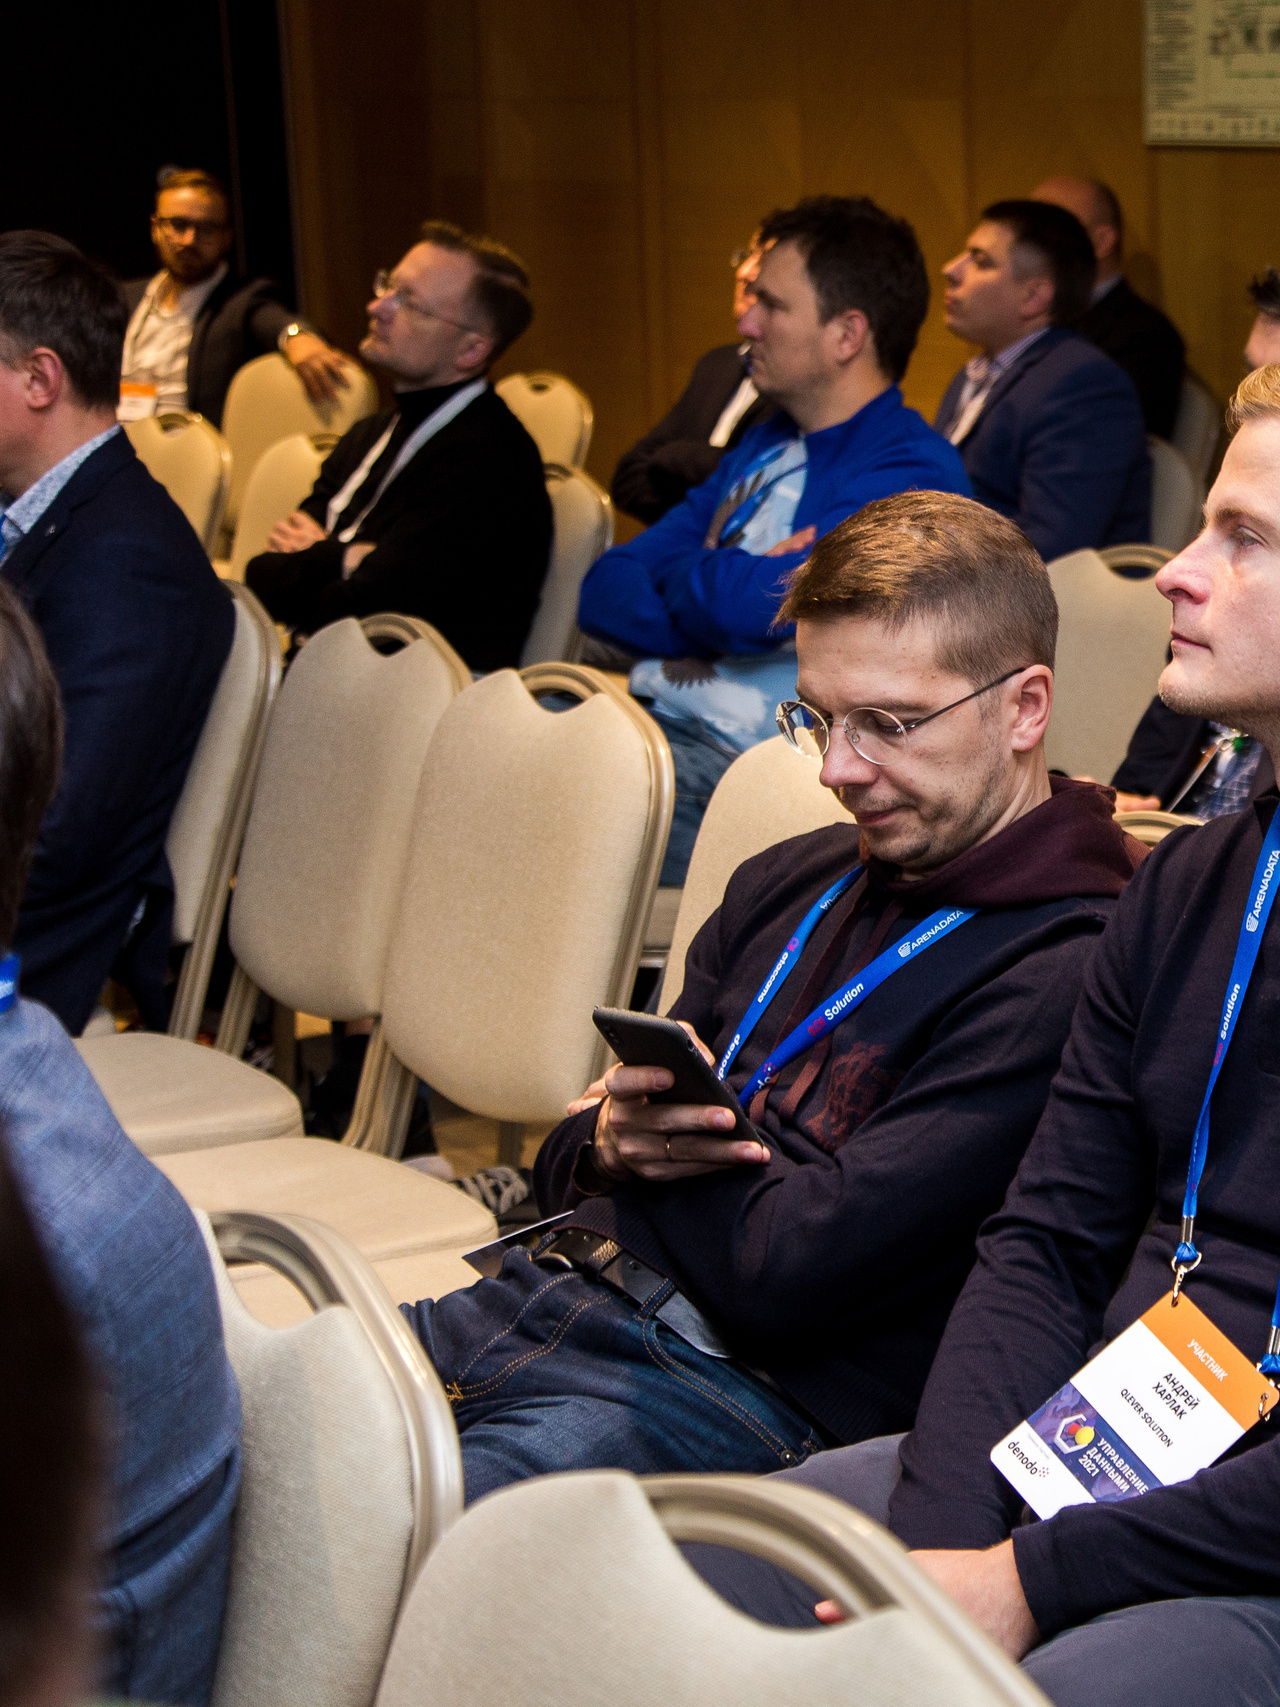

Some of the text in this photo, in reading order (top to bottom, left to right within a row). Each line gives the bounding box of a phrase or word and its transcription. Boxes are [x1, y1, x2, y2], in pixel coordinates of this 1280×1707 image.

[910, 908, 965, 951] ARENADATA
[757, 950, 789, 1004] ataccama
[806, 982, 864, 1038] SDI Solution
[1220, 983, 1240, 1040] Solution
[716, 1033, 741, 1081] denod
[1187, 1338, 1229, 1382] УЧАСТНИК
[1152, 1381, 1188, 1420] ХАРЛАК
[1162, 1373, 1202, 1411] АНДРЕЙ
[1120, 1388, 1174, 1448] QLEVER SOLUTION
[1007, 1440, 1038, 1476] denodo
[1077, 1454, 1101, 1478] 2021
[1085, 1447, 1132, 1494] ДАННЫМИ
[1096, 1437, 1150, 1496] УПРАВЛЕНИЕ
